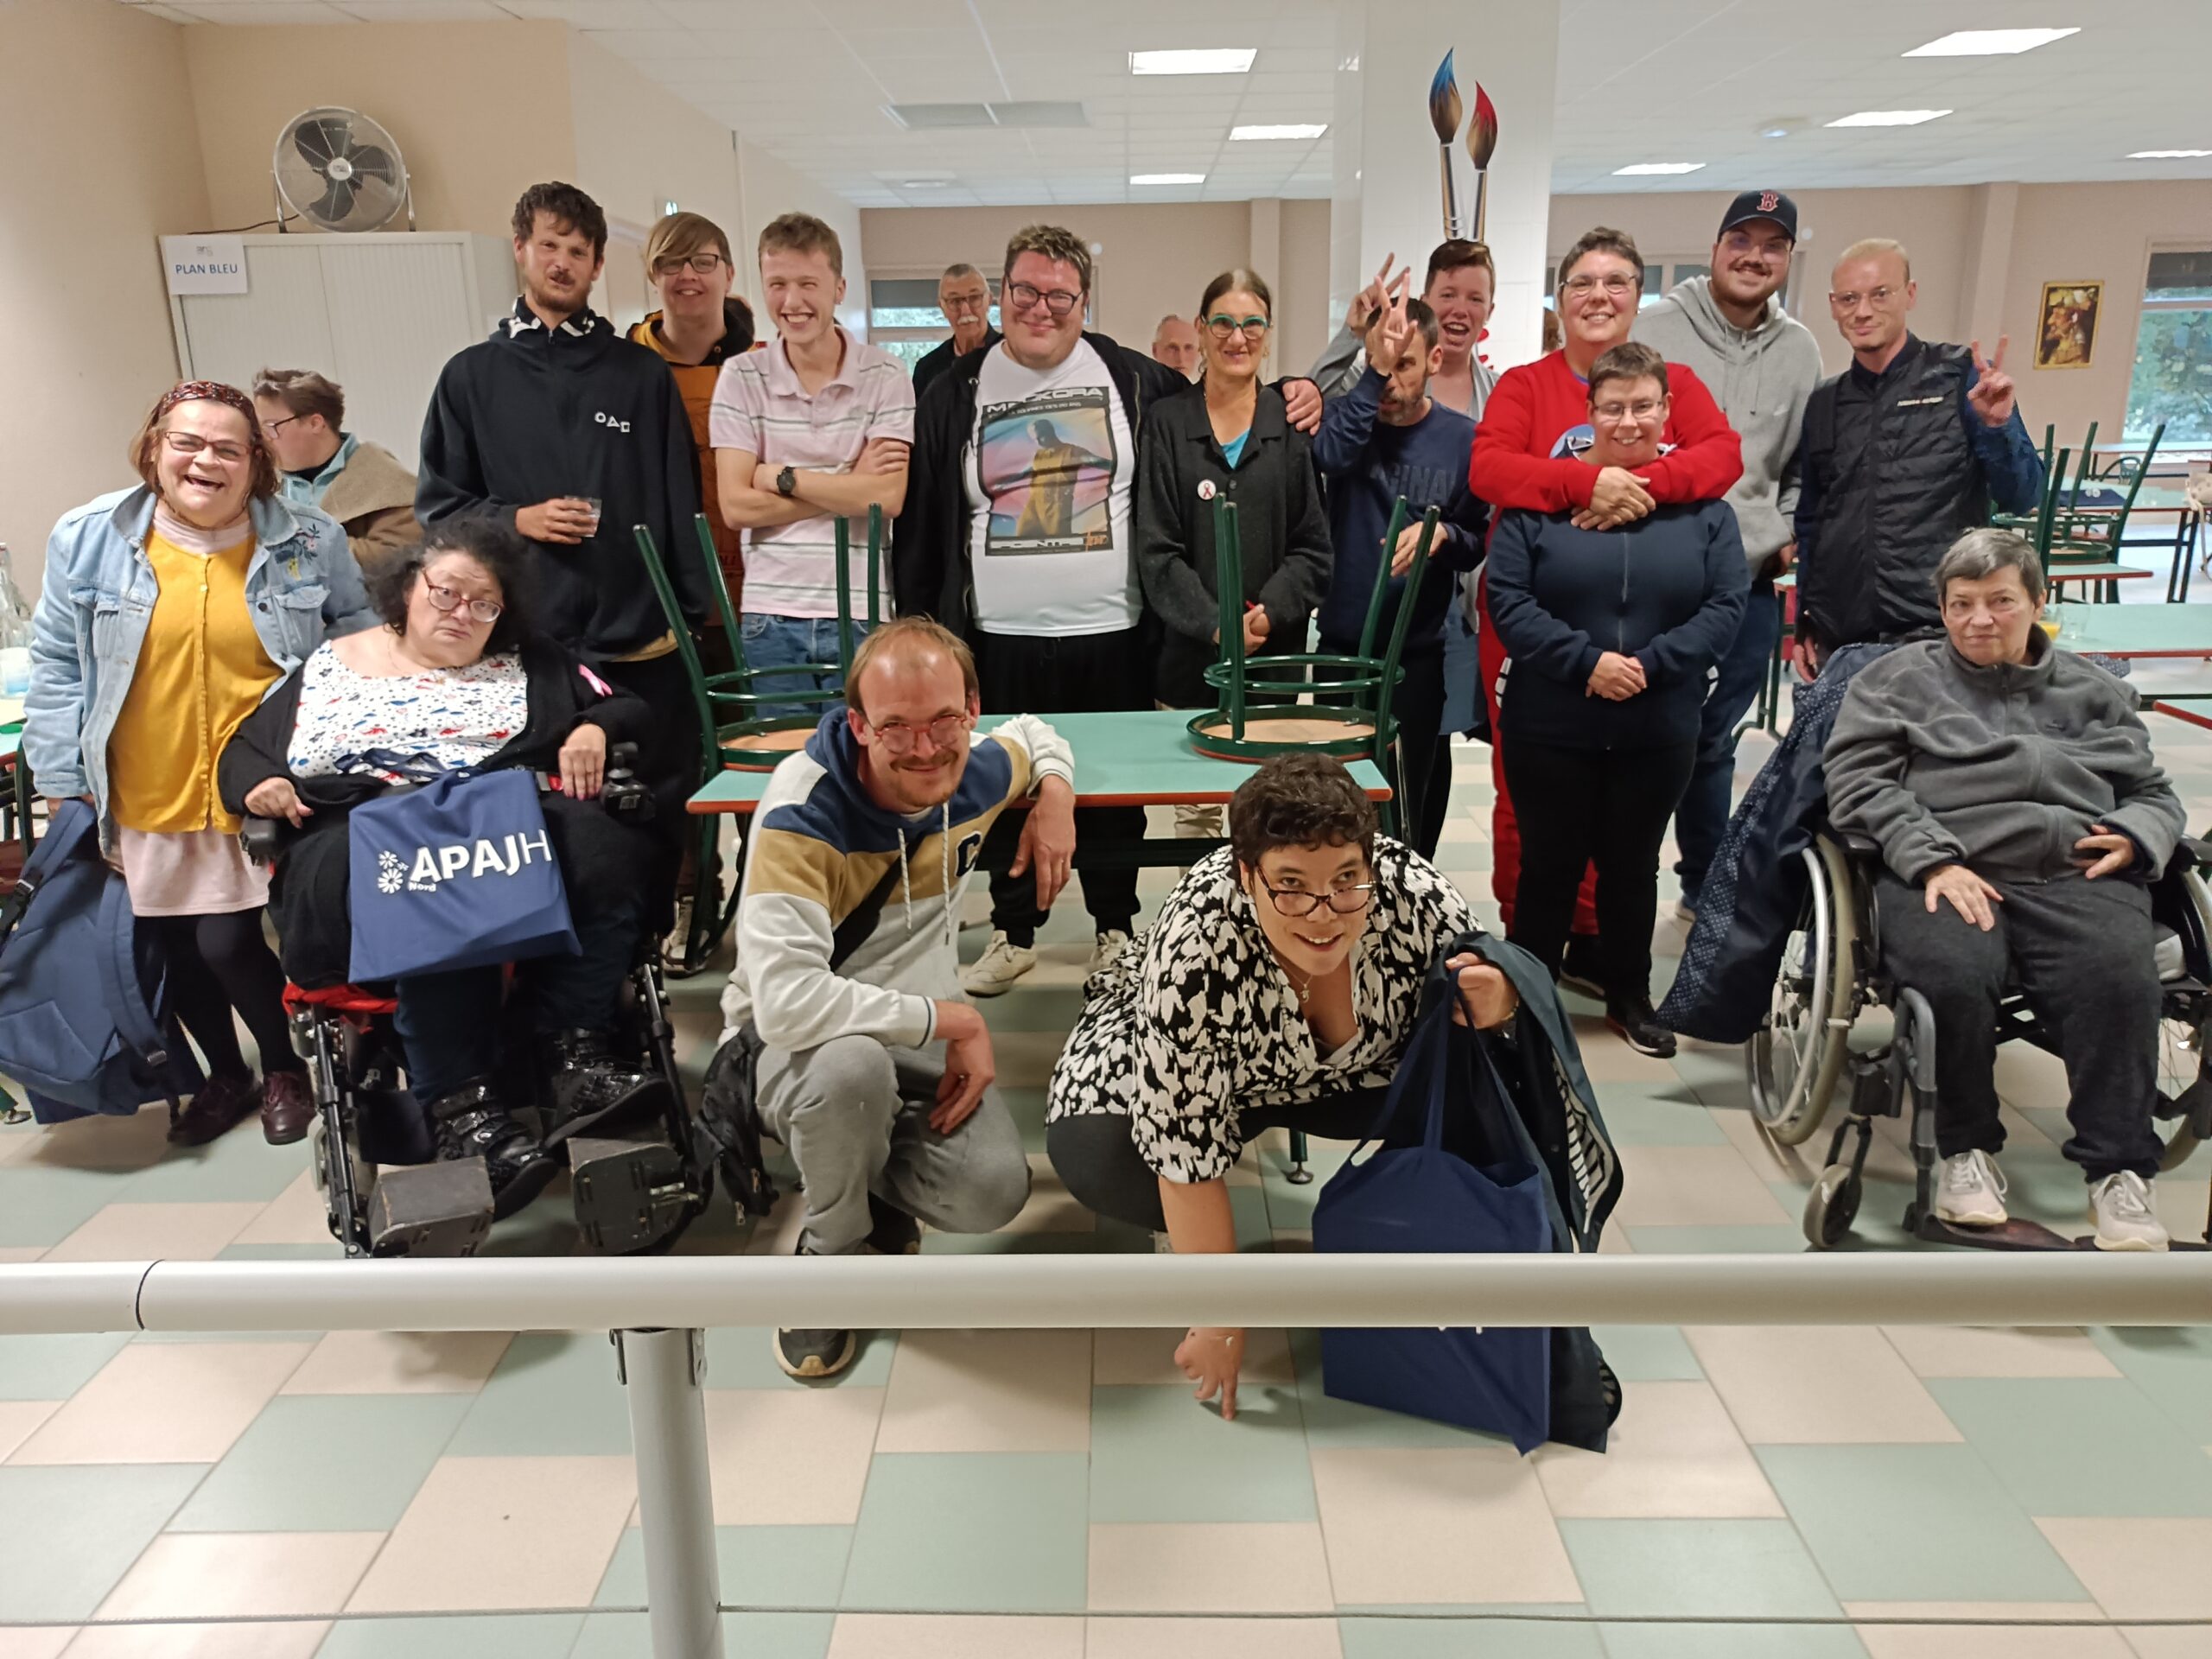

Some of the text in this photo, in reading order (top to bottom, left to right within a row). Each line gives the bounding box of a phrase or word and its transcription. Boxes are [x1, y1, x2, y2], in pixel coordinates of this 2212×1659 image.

[175, 264, 238, 275] PLAN BLEU
[409, 829, 553, 884] APAJH
[408, 880, 436, 893] Nord
